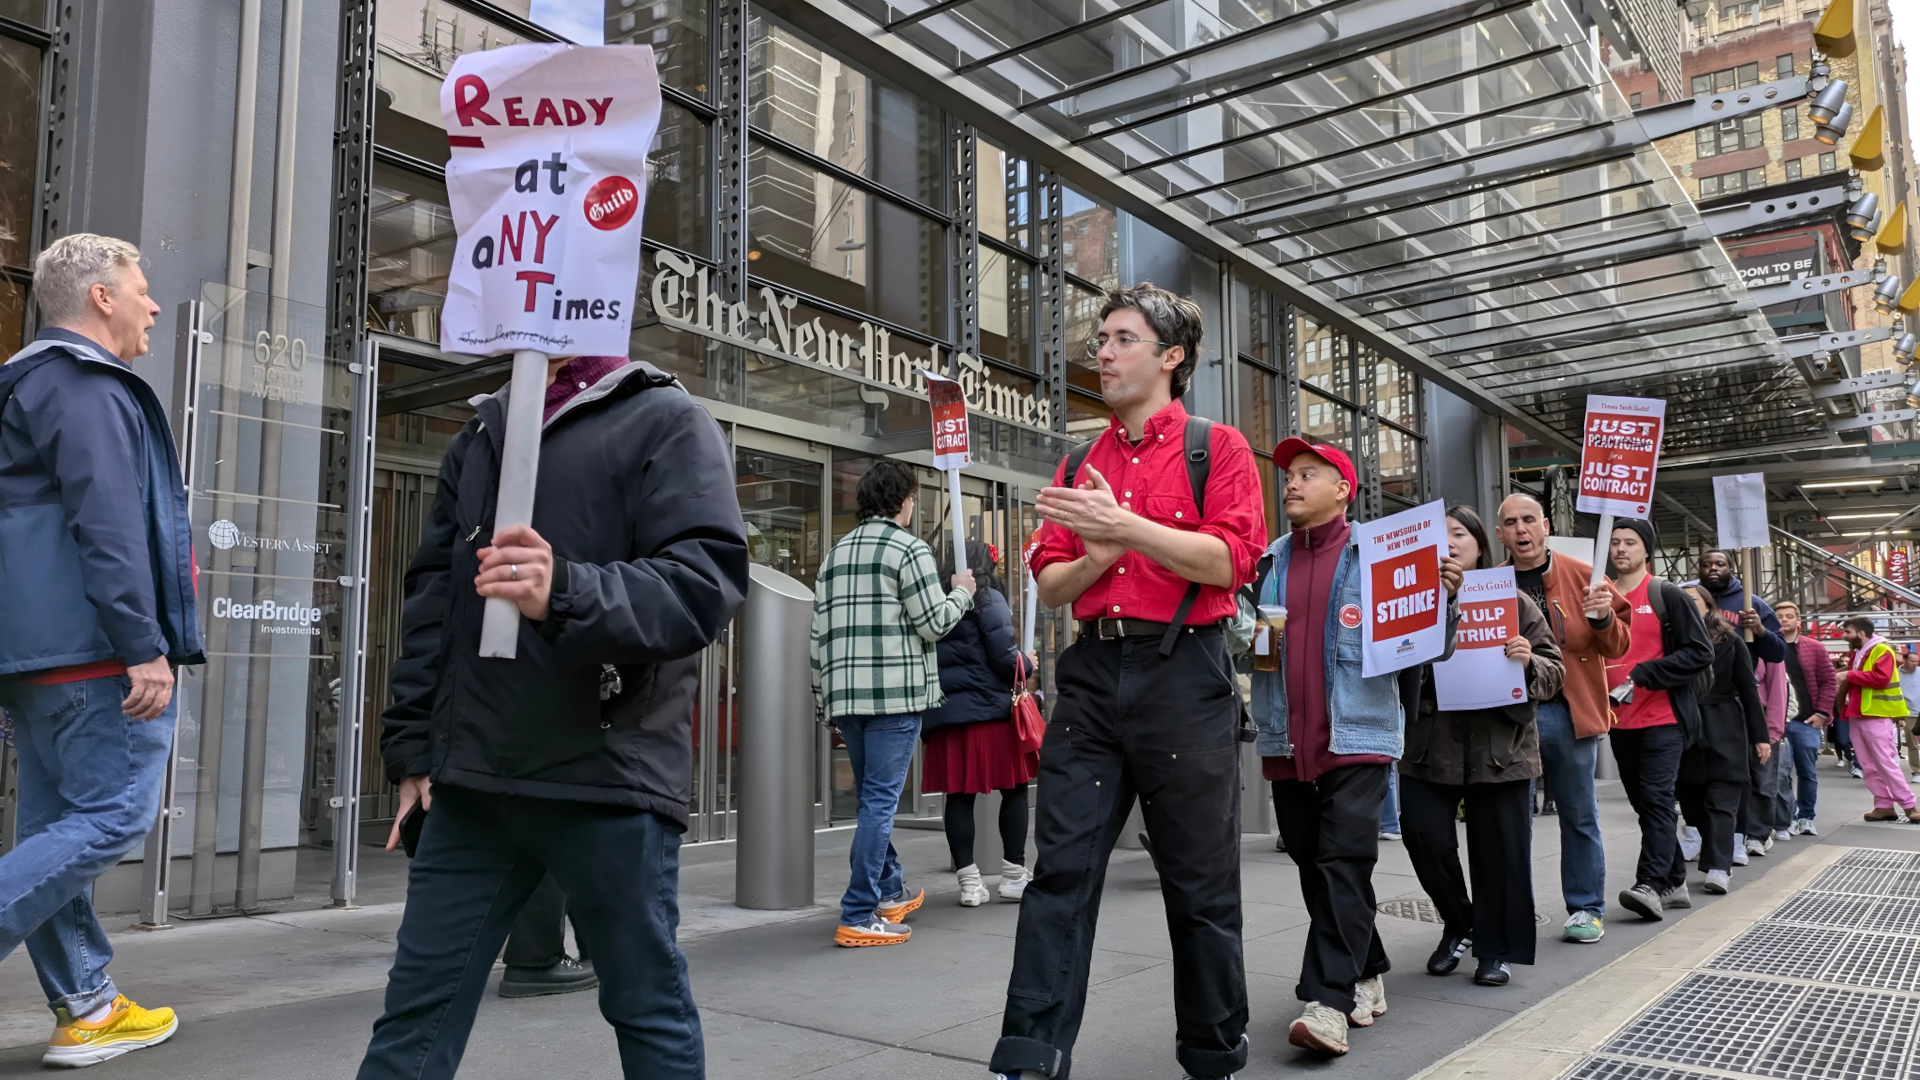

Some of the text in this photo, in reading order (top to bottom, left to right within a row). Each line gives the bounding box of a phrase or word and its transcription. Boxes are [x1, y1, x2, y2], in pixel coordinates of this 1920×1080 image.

[454, 74, 614, 127] READY
[515, 152, 567, 195] at
[588, 188, 634, 222] Guild
[471, 210, 560, 269] aNY
[1772, 262, 1791, 273] TO
[1794, 258, 1813, 270] BE
[515, 270, 621, 321] Times
[254, 330, 307, 371] 620
[651, 249, 1051, 430] The New York Times
[1588, 418, 1656, 436] JUST
[937, 433, 966, 450] CTRACT
[1584, 461, 1649, 480] JUST
[1583, 476, 1647, 497] CONTRACT
[228, 530, 332, 555] WESTERN ASSET
[1373, 519, 1431, 545] THE NEWSGUILD OF
[1387, 535, 1419, 552] NEW YORK
[1393, 563, 1417, 590] ON
[1463, 580, 1513, 593] Tech Guild
[213, 597, 322, 626] ClearBridge
[1377, 588, 1436, 624] STRIKE
[1461, 607, 1505, 623] N ULP
[1718, 609, 1739, 626] ON
[261, 624, 321, 635] Investments
[1457, 626, 1507, 643] TRIKE
